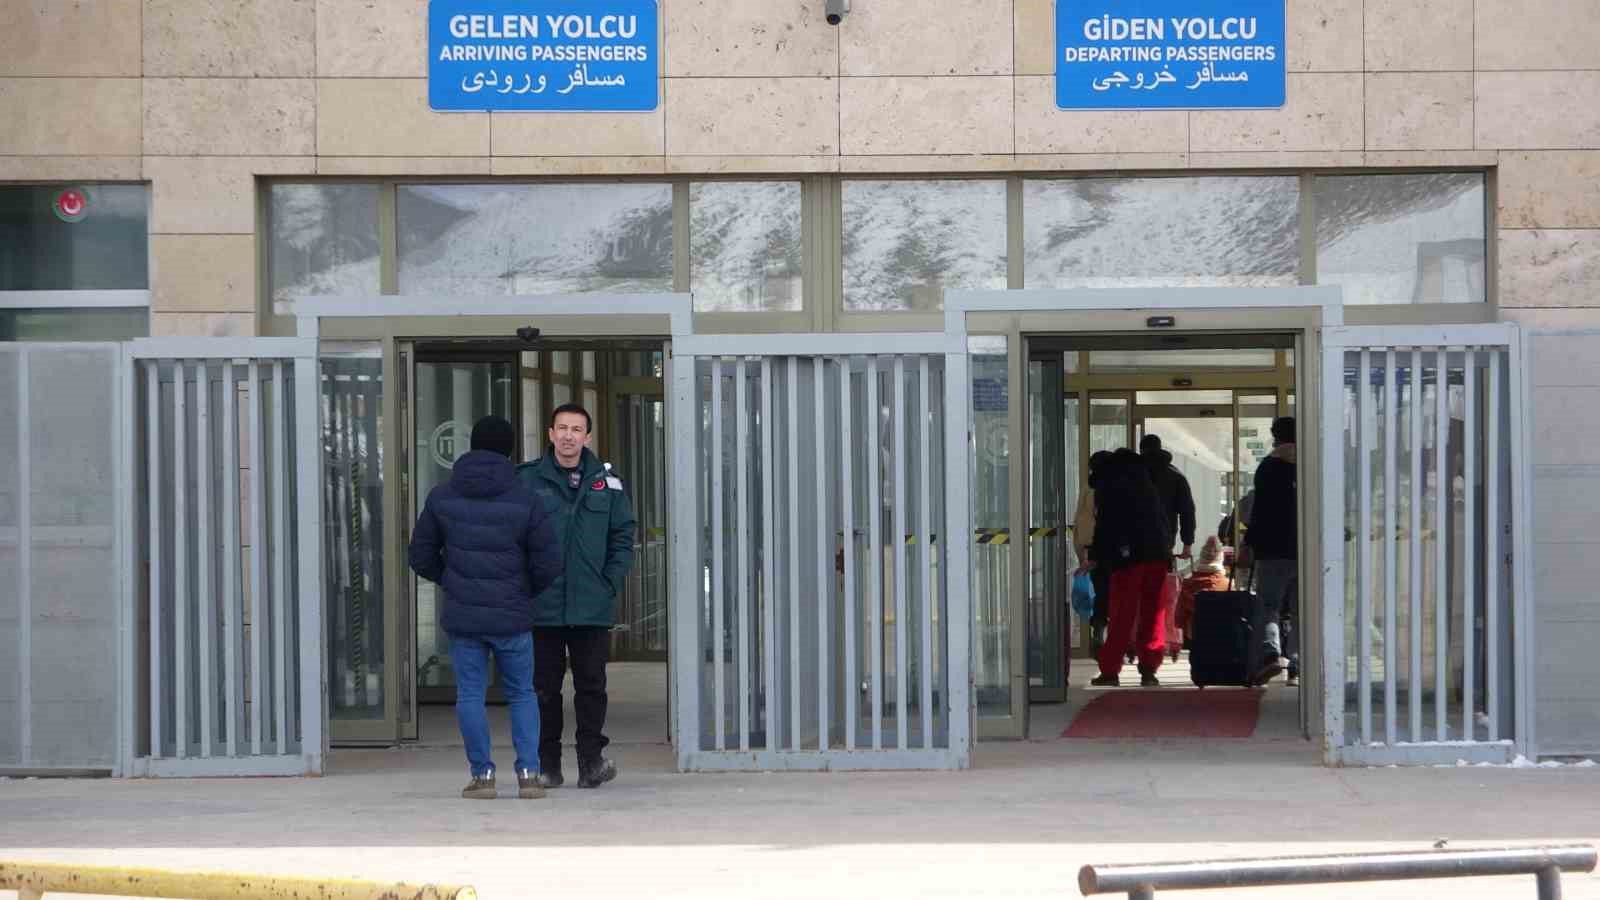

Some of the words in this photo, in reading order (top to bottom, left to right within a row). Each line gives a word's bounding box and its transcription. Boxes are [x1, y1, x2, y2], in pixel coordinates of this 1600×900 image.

[449, 15, 539, 39] GELEN
[546, 15, 637, 39] YOLCU
[1083, 14, 1165, 41] GİDEN
[1171, 17, 1257, 40] YOLCU
[440, 45, 527, 61] ARRIVING
[532, 45, 648, 61] PASSENGERS
[1065, 47, 1162, 62] DEPARTING
[1166, 46, 1277, 61] PASSENGERS
[461, 69, 547, 93] ورودی
[556, 63, 626, 94] مسافر
[1092, 64, 1177, 91] خروجی
[1185, 61, 1249, 90] مسافر
